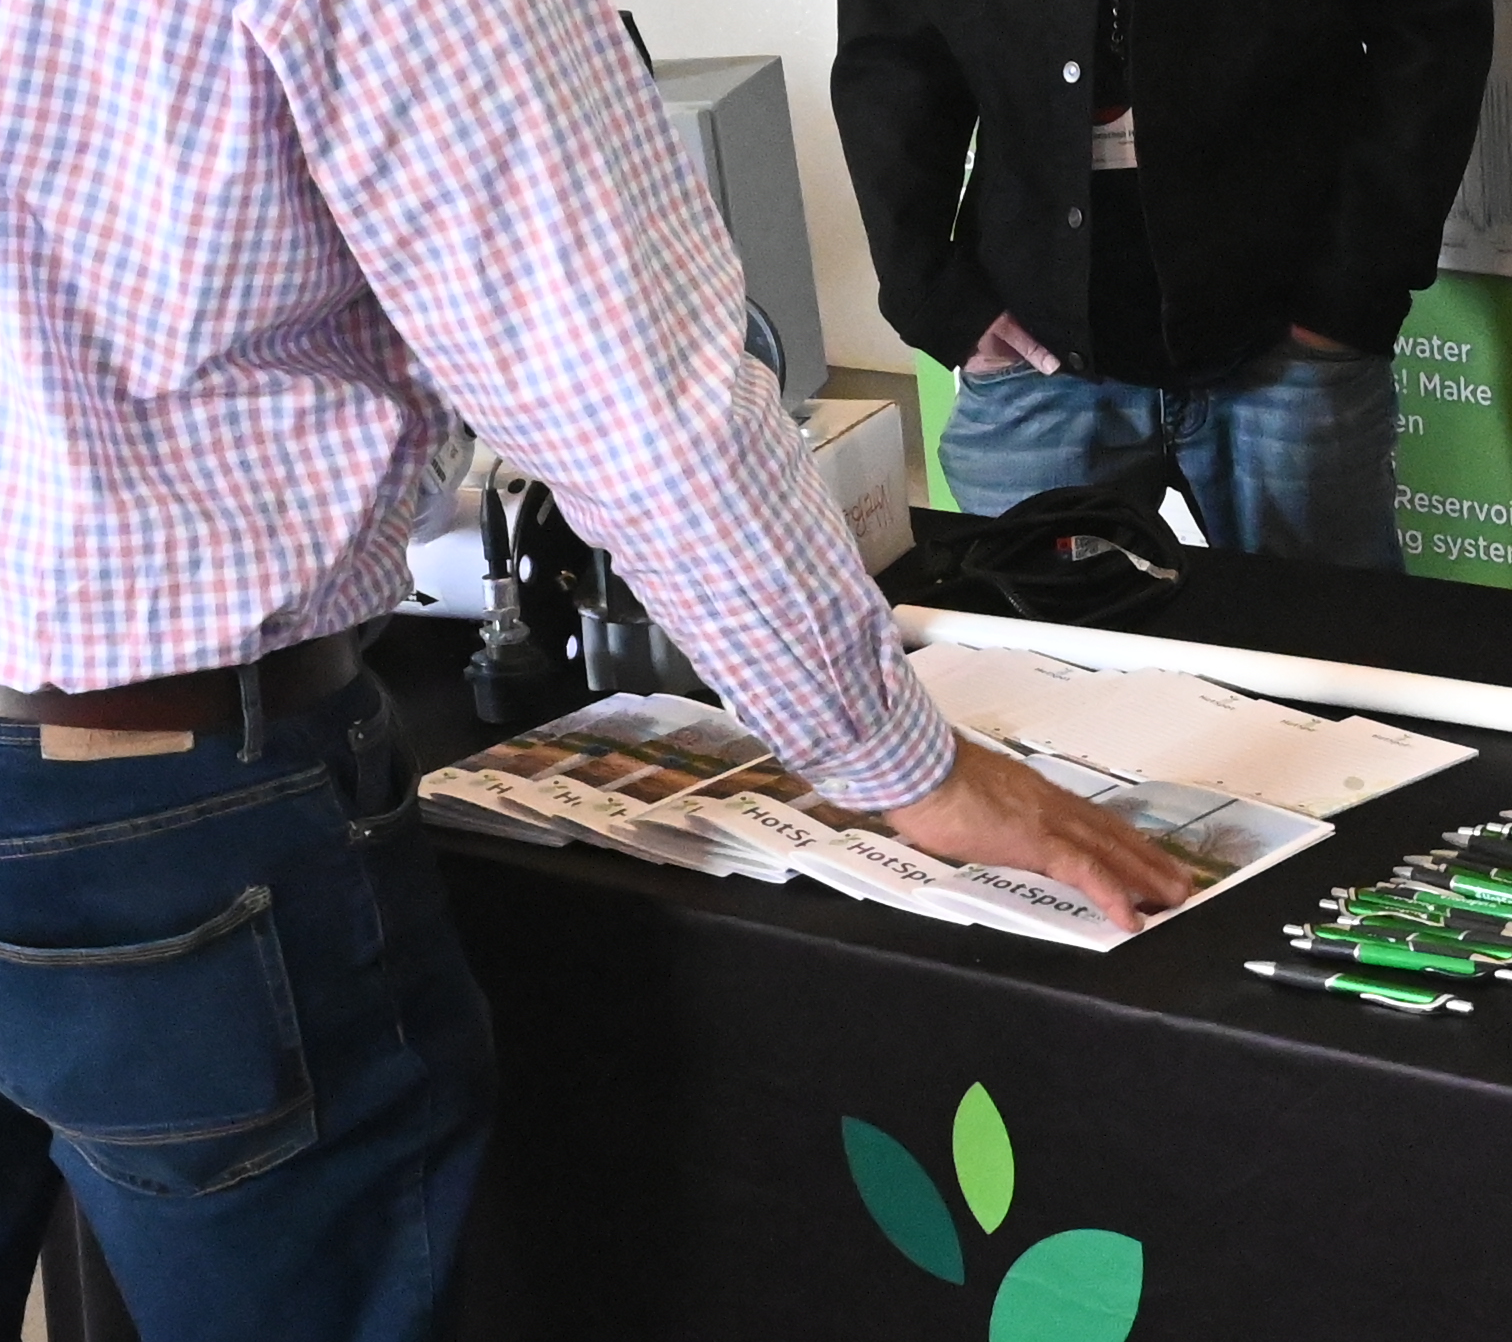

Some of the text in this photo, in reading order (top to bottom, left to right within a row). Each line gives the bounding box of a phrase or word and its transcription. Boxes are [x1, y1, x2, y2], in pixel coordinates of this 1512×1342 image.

[1394, 334, 1471, 363] water
[1419, 371, 1492, 406] Make
[976, 869, 1089, 919] HotSpot
